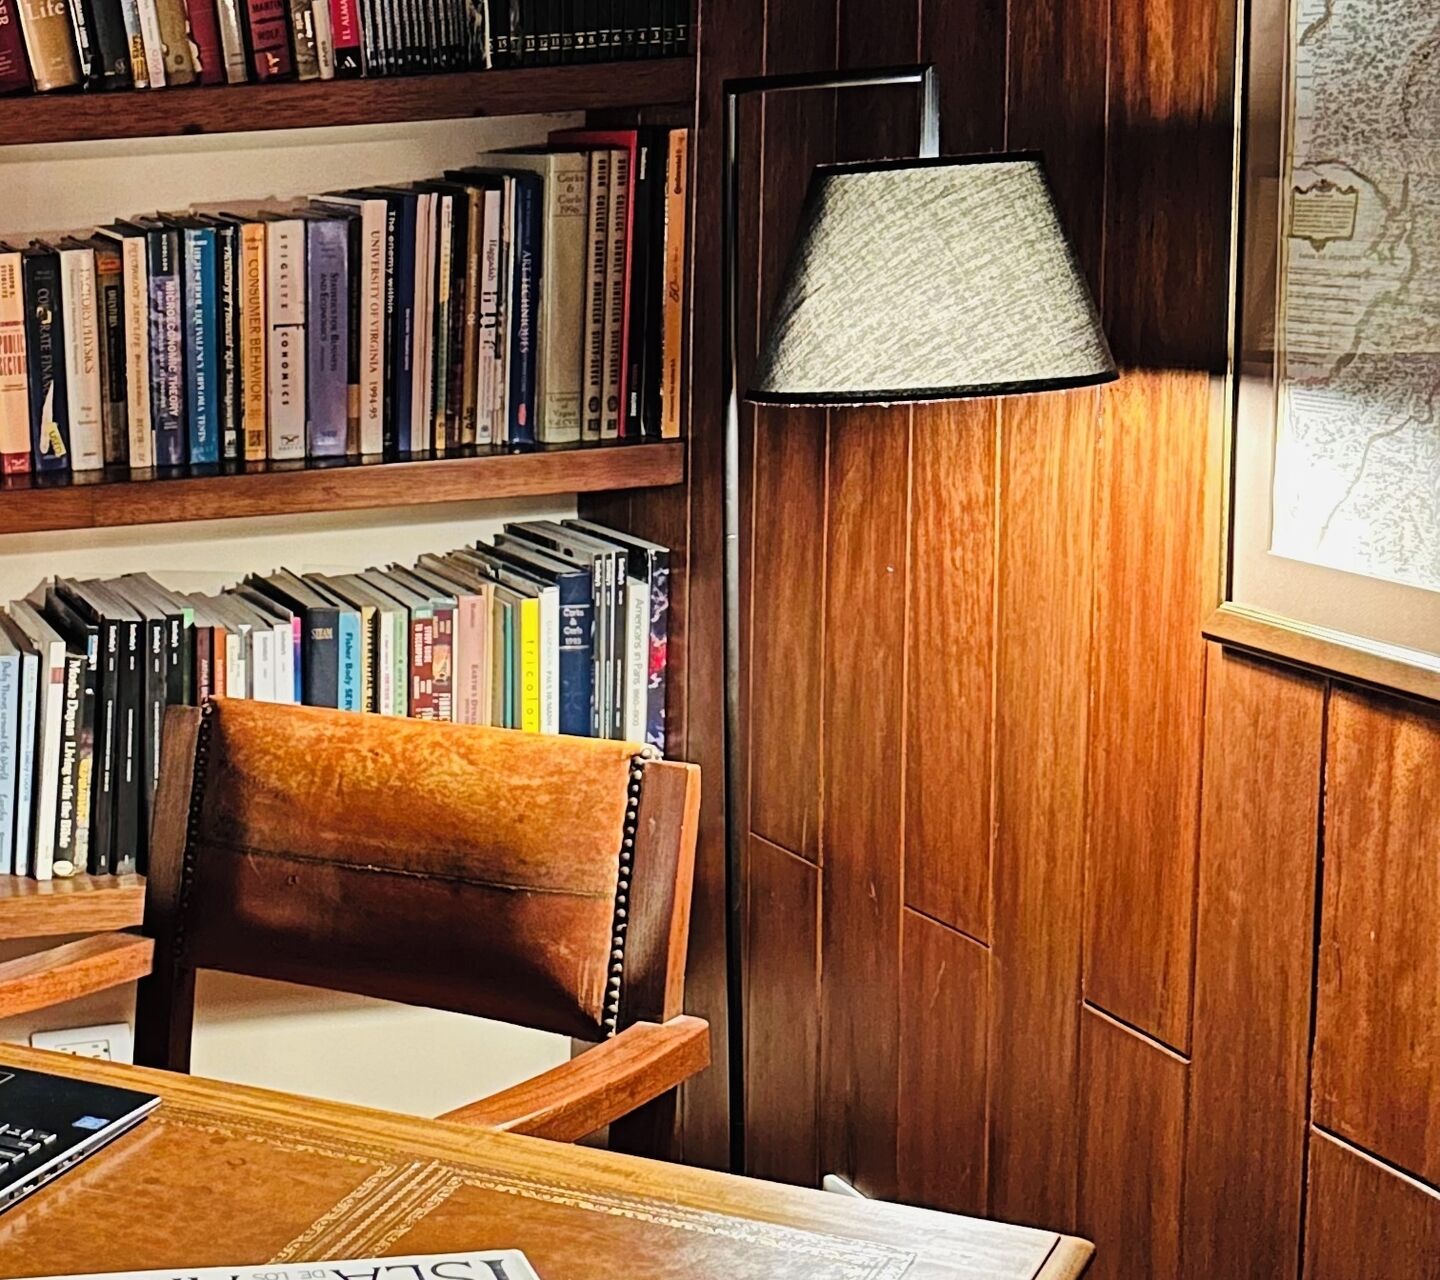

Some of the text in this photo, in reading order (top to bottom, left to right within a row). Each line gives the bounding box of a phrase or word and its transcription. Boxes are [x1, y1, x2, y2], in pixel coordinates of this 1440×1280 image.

[341, 28, 351, 40] EL
[385, 234, 395, 314] enemy within
[485, 238, 497, 282] Haggadah
[247, 257, 262, 402] CONSUMER BEHAVIOR
[368, 229, 379, 420] UNIVERSITY VIRGINIA 1994-95
[516, 248, 532, 354] ART TECHNIQUES
[82, 323, 95, 374] PHYSICS
[163, 280, 179, 416] MICROECONOMIC THEORY
[342, 632, 353, 685] Fisher Body
[632, 597, 645, 649] Americans
[63, 659, 81, 737] Moshe Dayan
[58, 740, 77, 849] Living with the Bible
